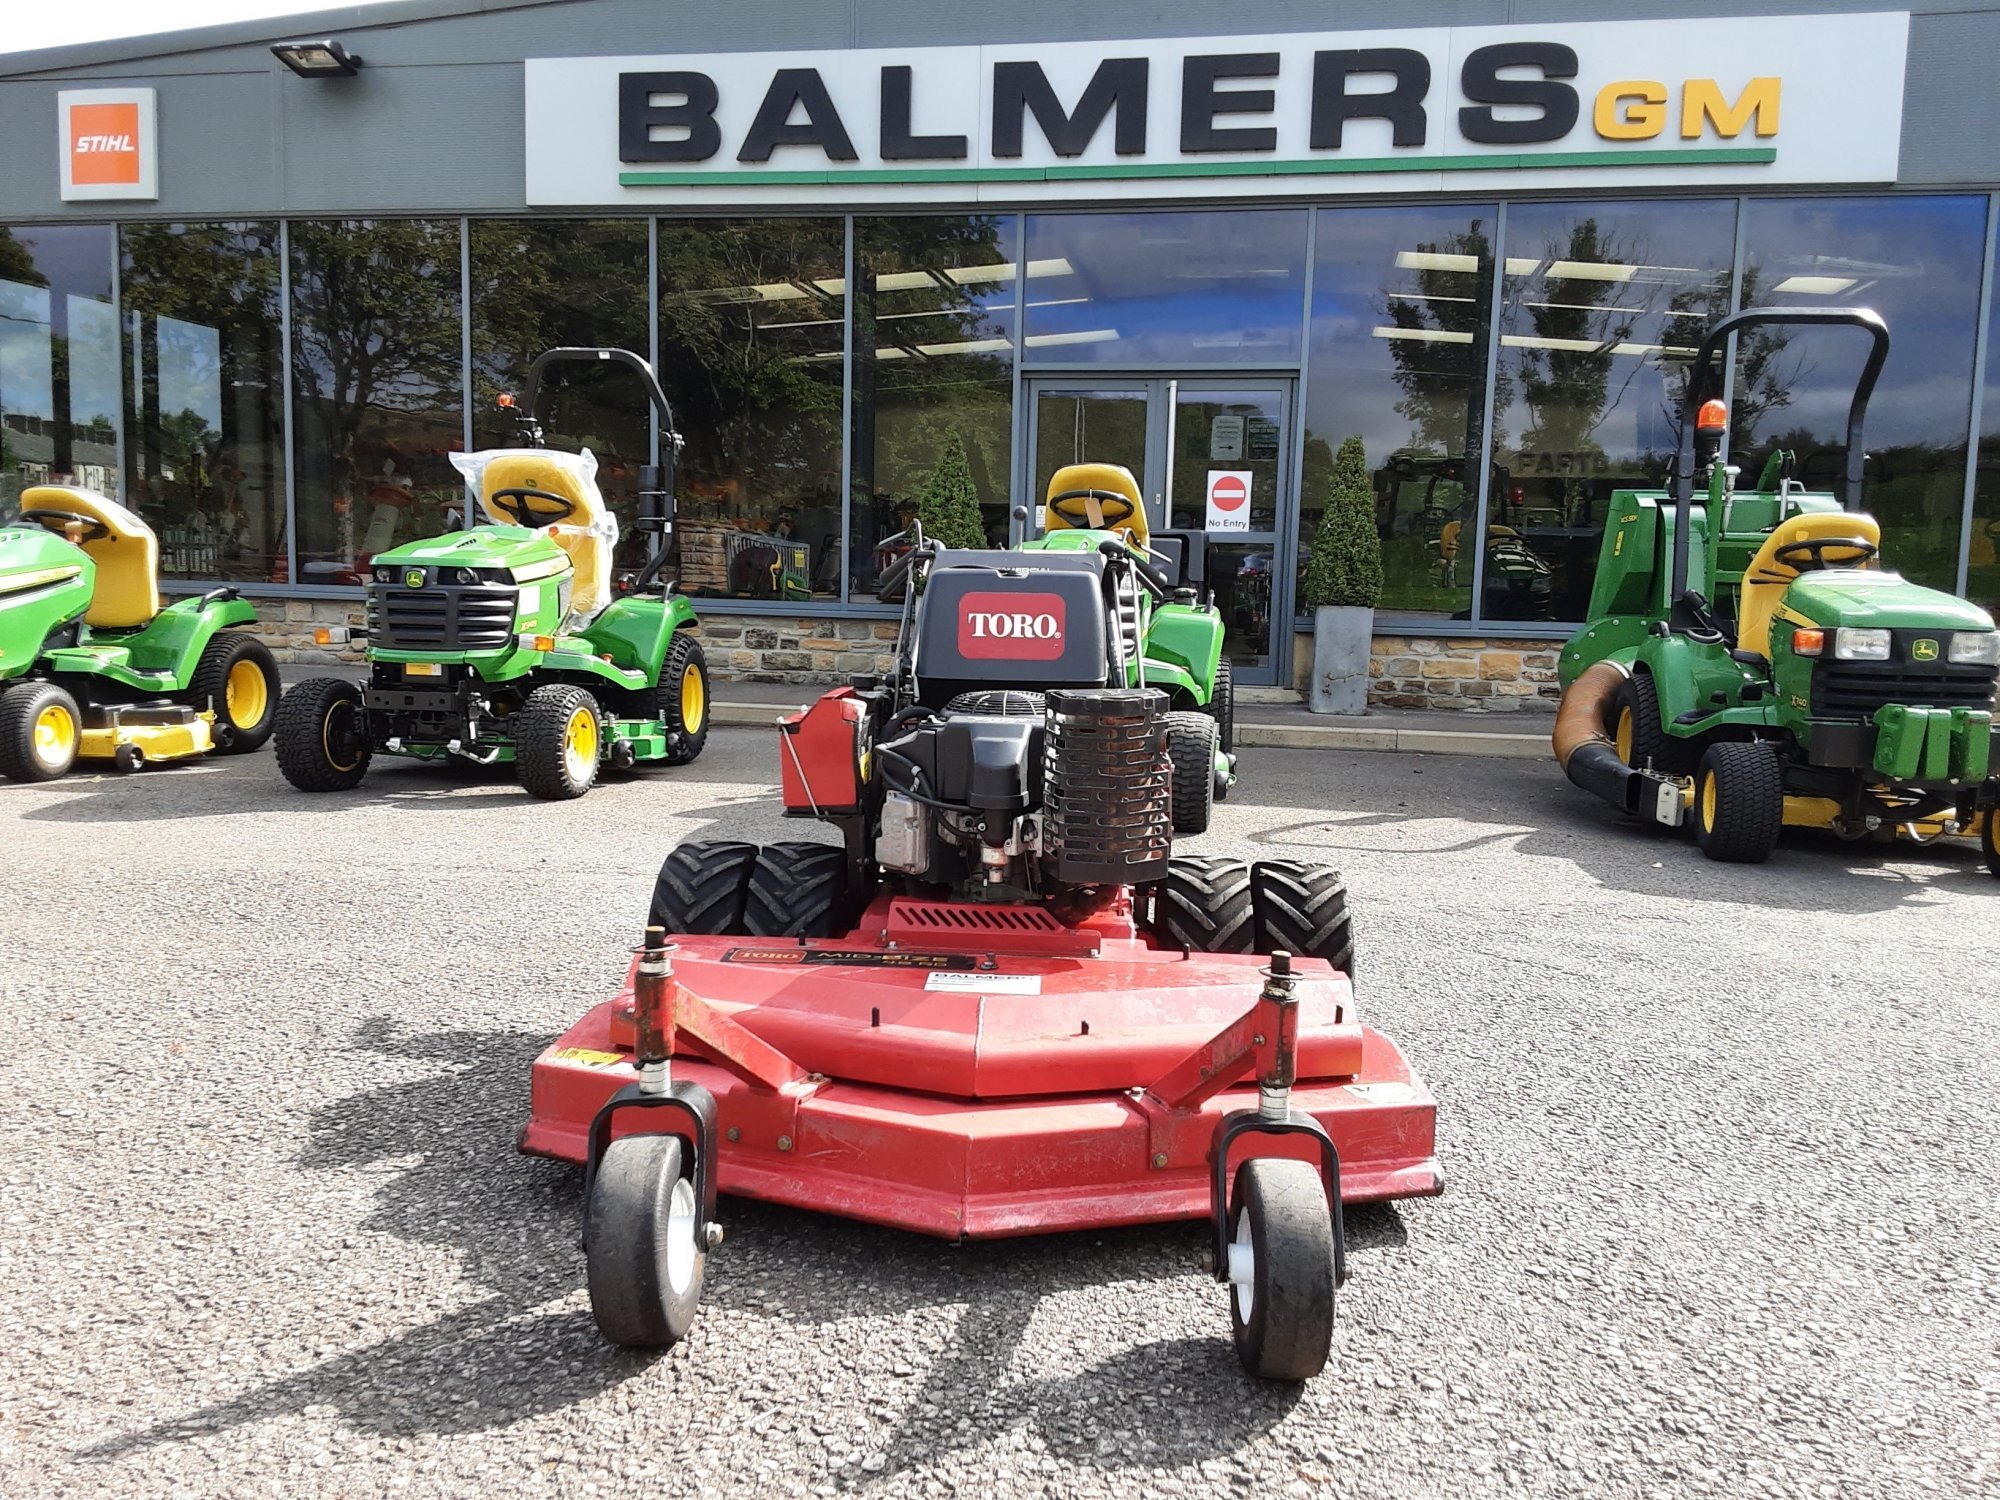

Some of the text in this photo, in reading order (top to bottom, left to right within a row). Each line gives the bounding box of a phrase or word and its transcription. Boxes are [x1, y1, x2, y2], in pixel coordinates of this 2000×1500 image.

[618, 41, 1782, 163] BALMERS GM
[76, 135, 135, 153] STIHL
[1208, 519, 1247, 530] No Entry
[968, 613, 1058, 639] TORO
